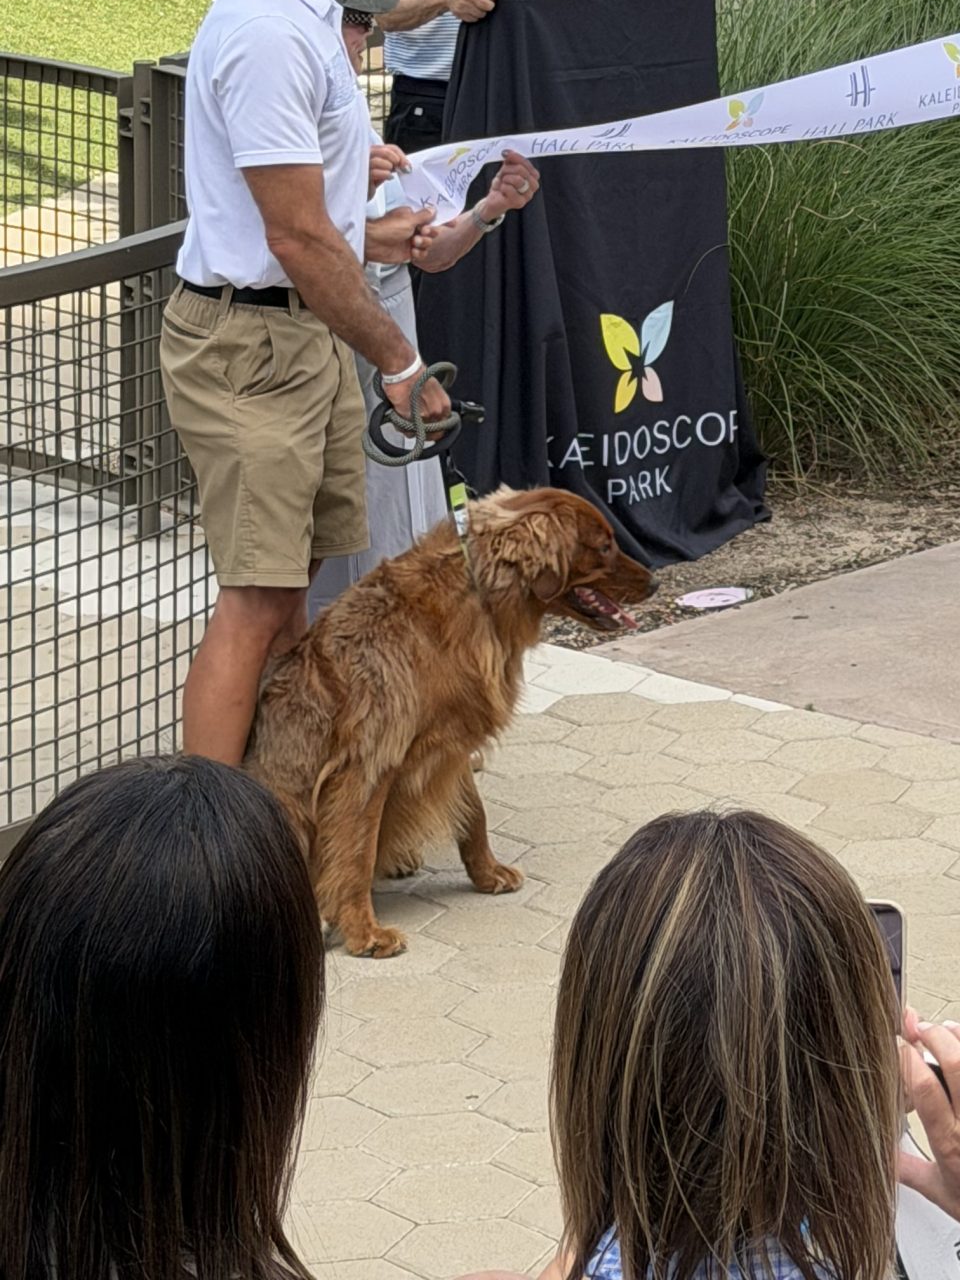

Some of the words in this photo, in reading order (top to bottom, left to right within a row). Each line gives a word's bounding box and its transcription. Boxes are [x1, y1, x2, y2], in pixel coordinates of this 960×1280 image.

[801, 121, 848, 138] HALL
[852, 111, 900, 132] PARK
[530, 138, 580, 154] HALL
[607, 465, 673, 505] PARK
